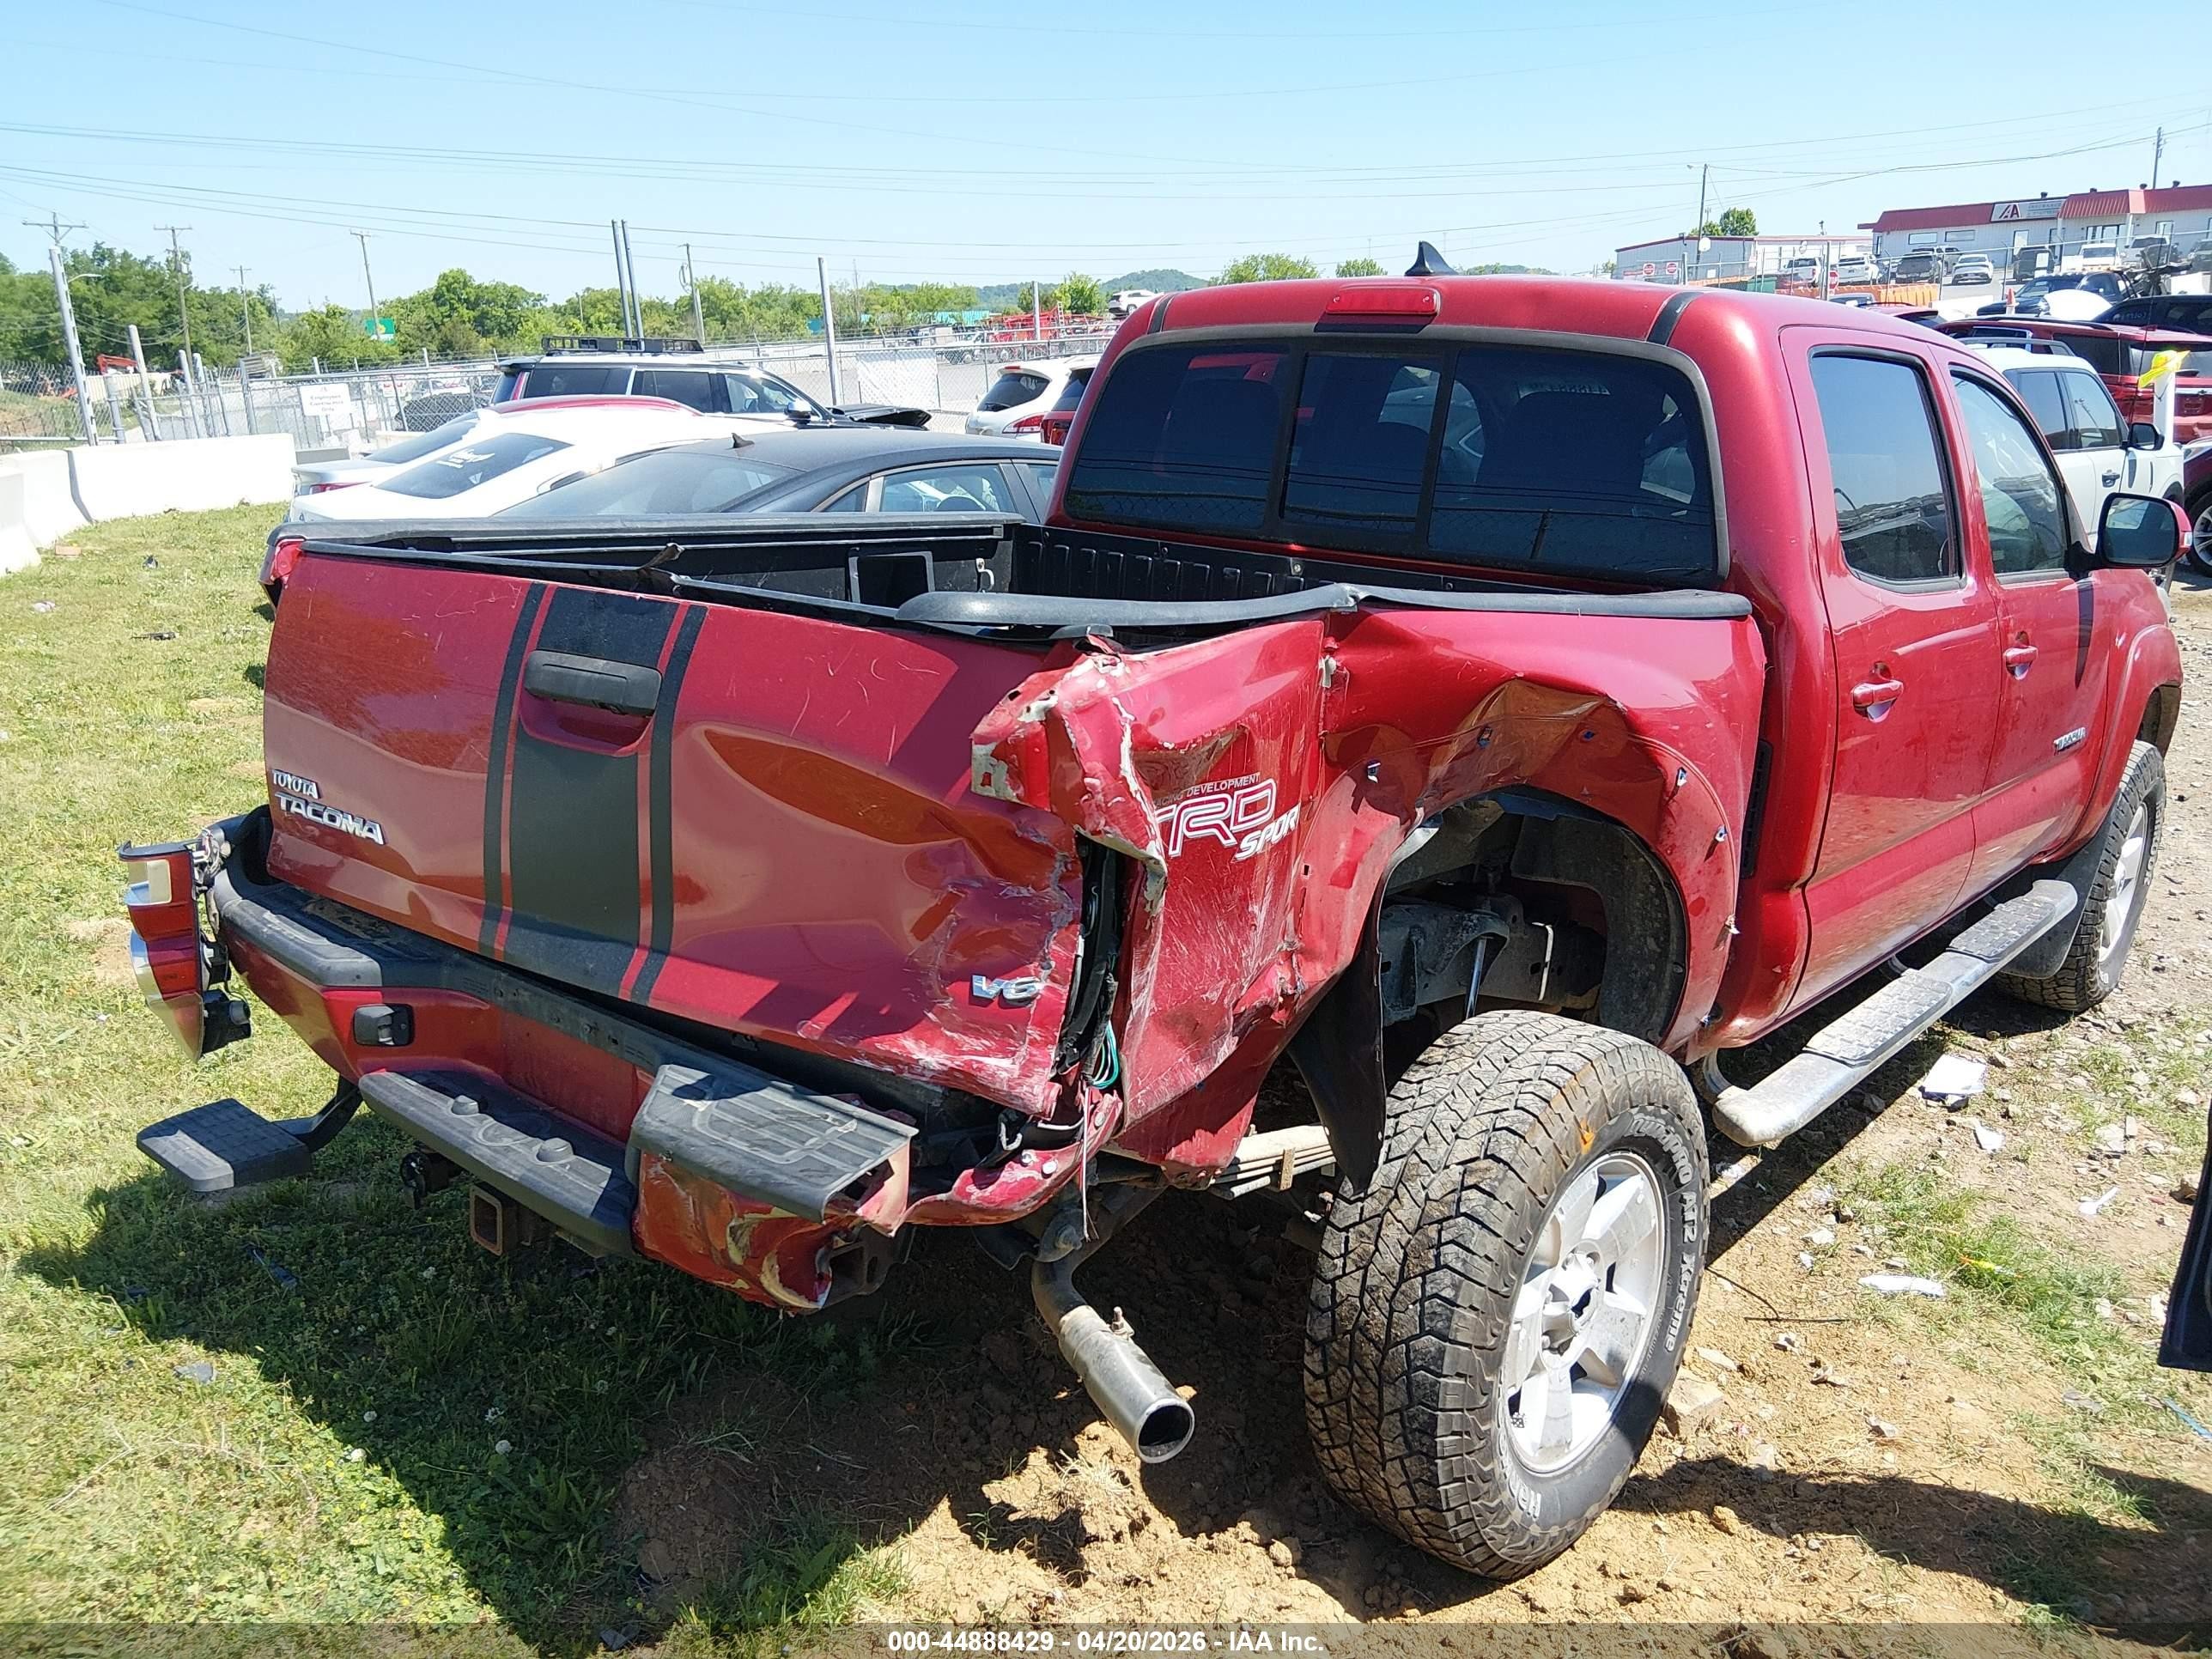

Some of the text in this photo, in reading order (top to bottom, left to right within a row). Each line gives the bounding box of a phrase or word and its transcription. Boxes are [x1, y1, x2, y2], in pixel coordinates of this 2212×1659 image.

[272, 769, 319, 799] TOYOTA
[1185, 772, 1261, 798] DEVELOPMENT
[275, 792, 385, 845] TACOMA
[1234, 802, 1301, 861] SPOR
[972, 975, 1042, 1000] V6
[1680, 1190, 1698, 1244] AT2
[1664, 1250, 1697, 1354] Xtreme
